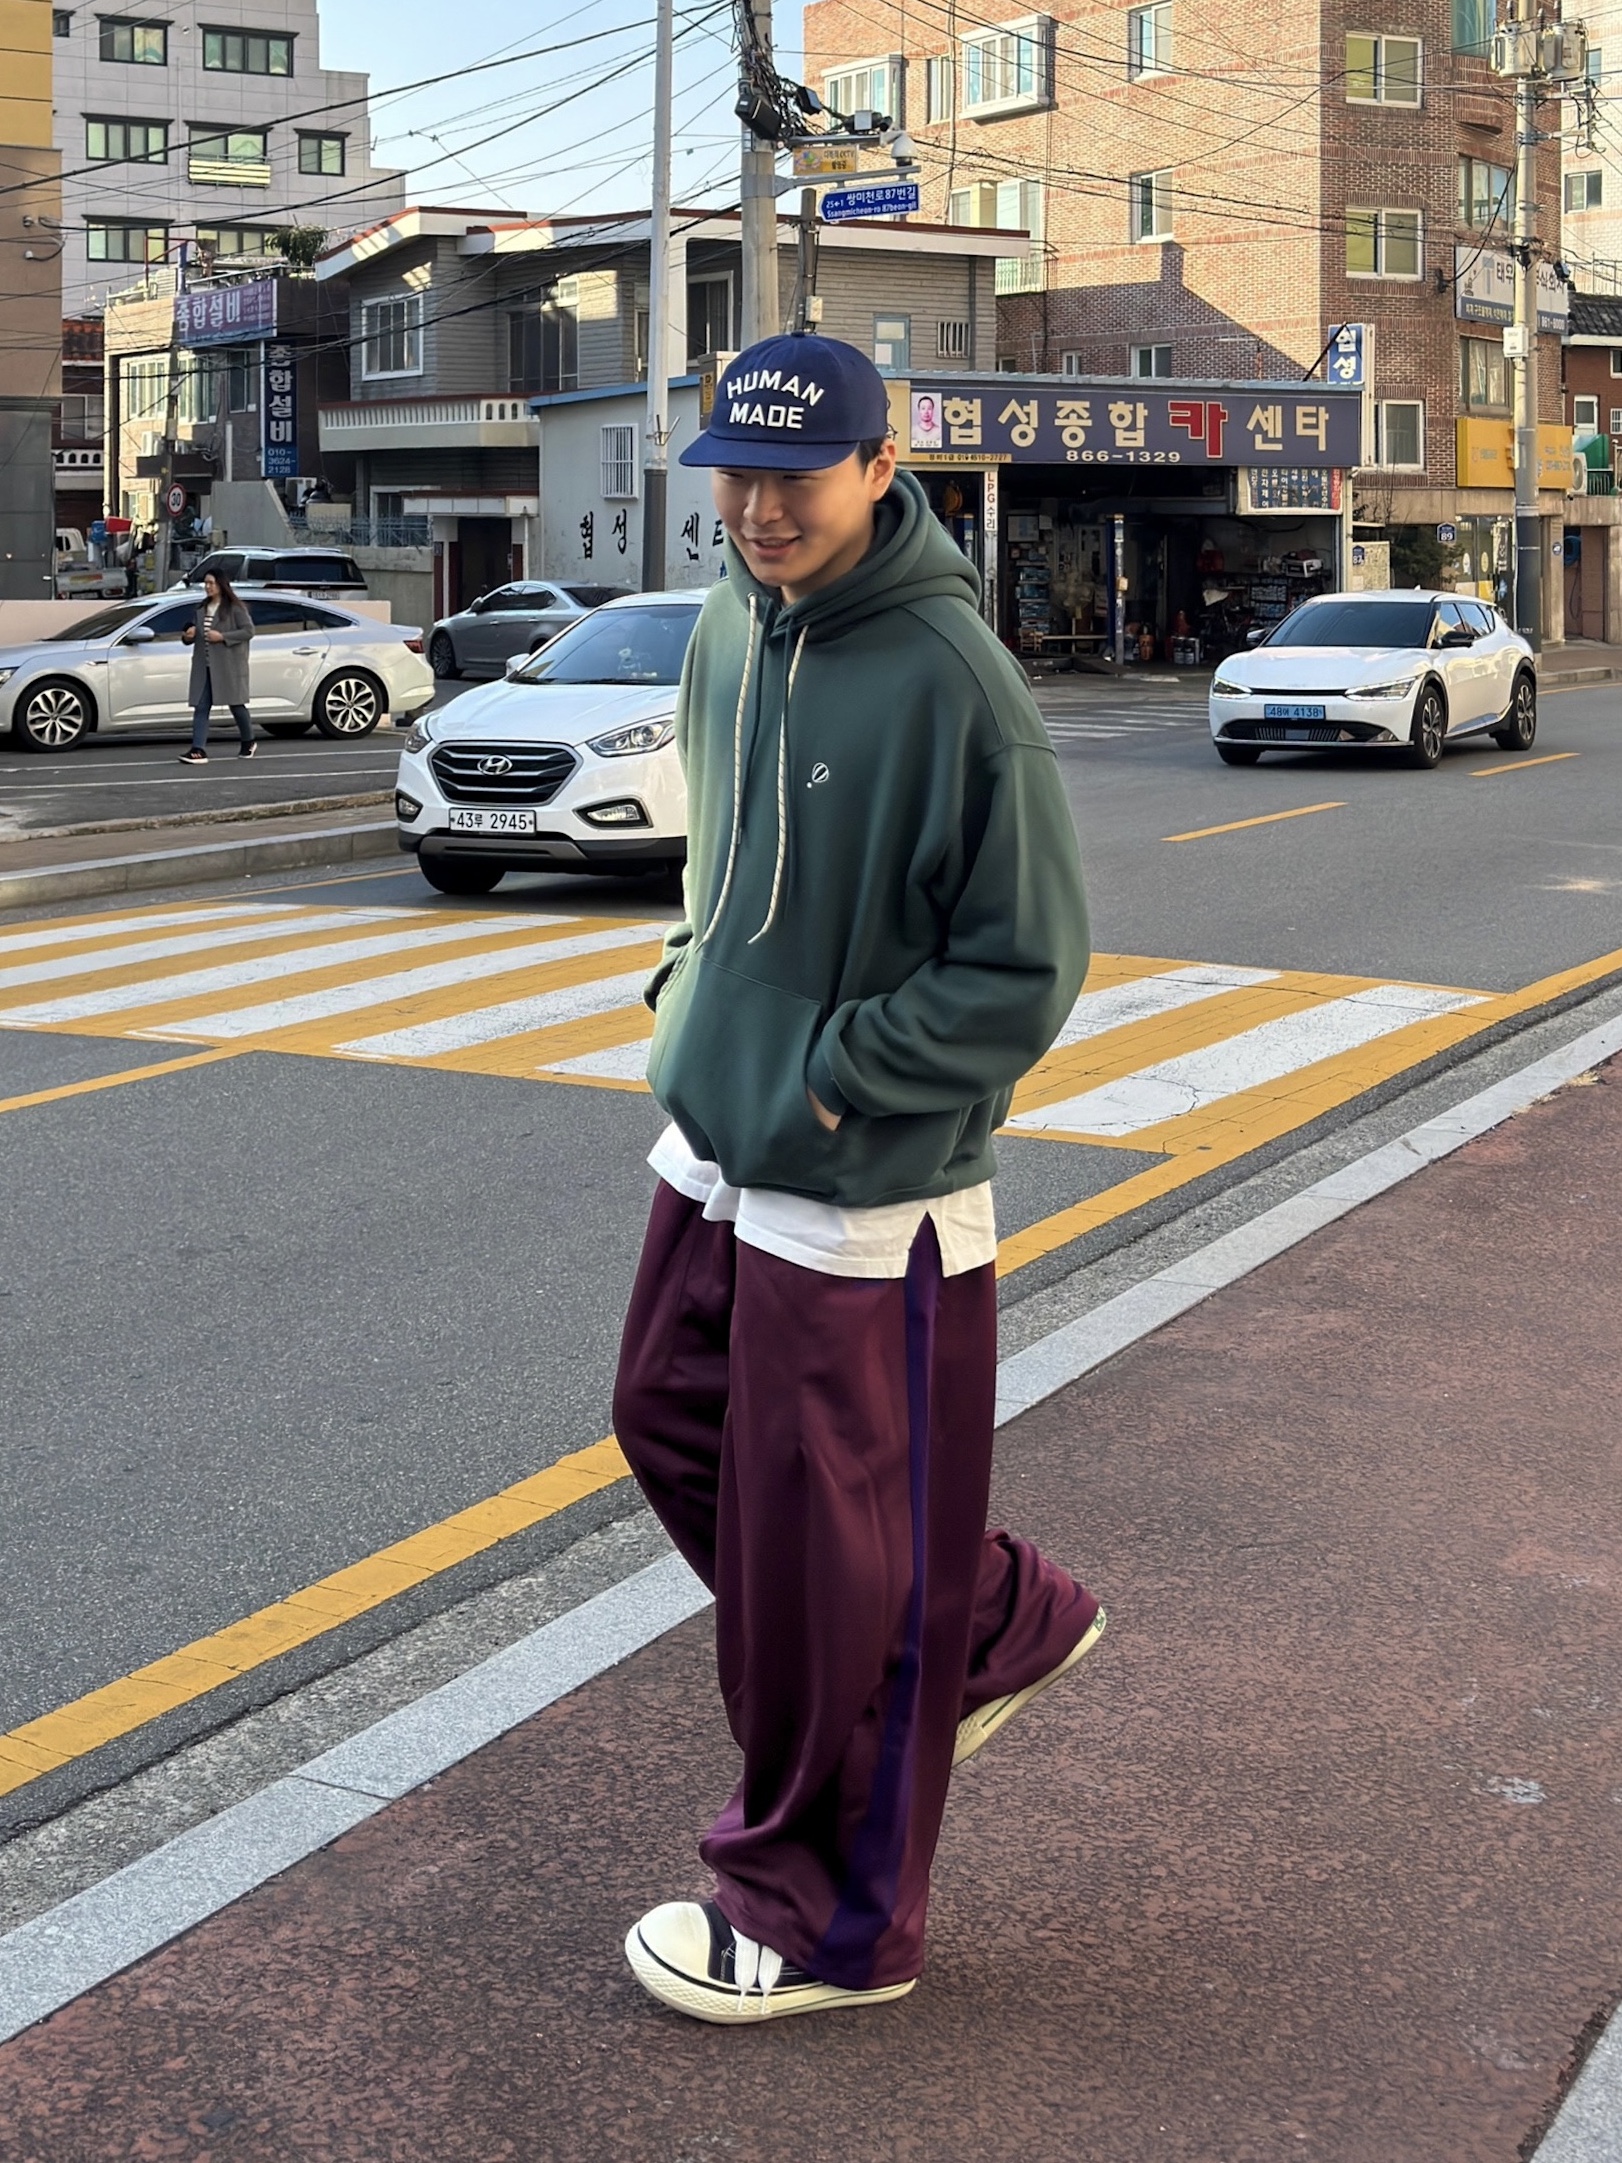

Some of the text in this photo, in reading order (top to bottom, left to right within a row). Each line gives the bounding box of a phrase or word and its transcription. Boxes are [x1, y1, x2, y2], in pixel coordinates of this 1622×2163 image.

[846, 186, 917, 206] 쌍미천로87번길
[827, 206, 881, 218] Ssangmicheon-ro
[176, 290, 241, 332] 종합설비
[268, 344, 293, 443] 종합설비
[727, 369, 825, 407] HUMAN
[729, 402, 805, 429] MADE
[1066, 449, 1181, 463] 866-1329
[987, 473, 995, 503] LPG
[172, 492, 181, 506] 30
[986, 507, 995, 529] 수리
[1440, 532, 1453, 541] 89
[1294, 707, 1318, 717] 4138
[457, 812, 527, 830] 43루 2945
